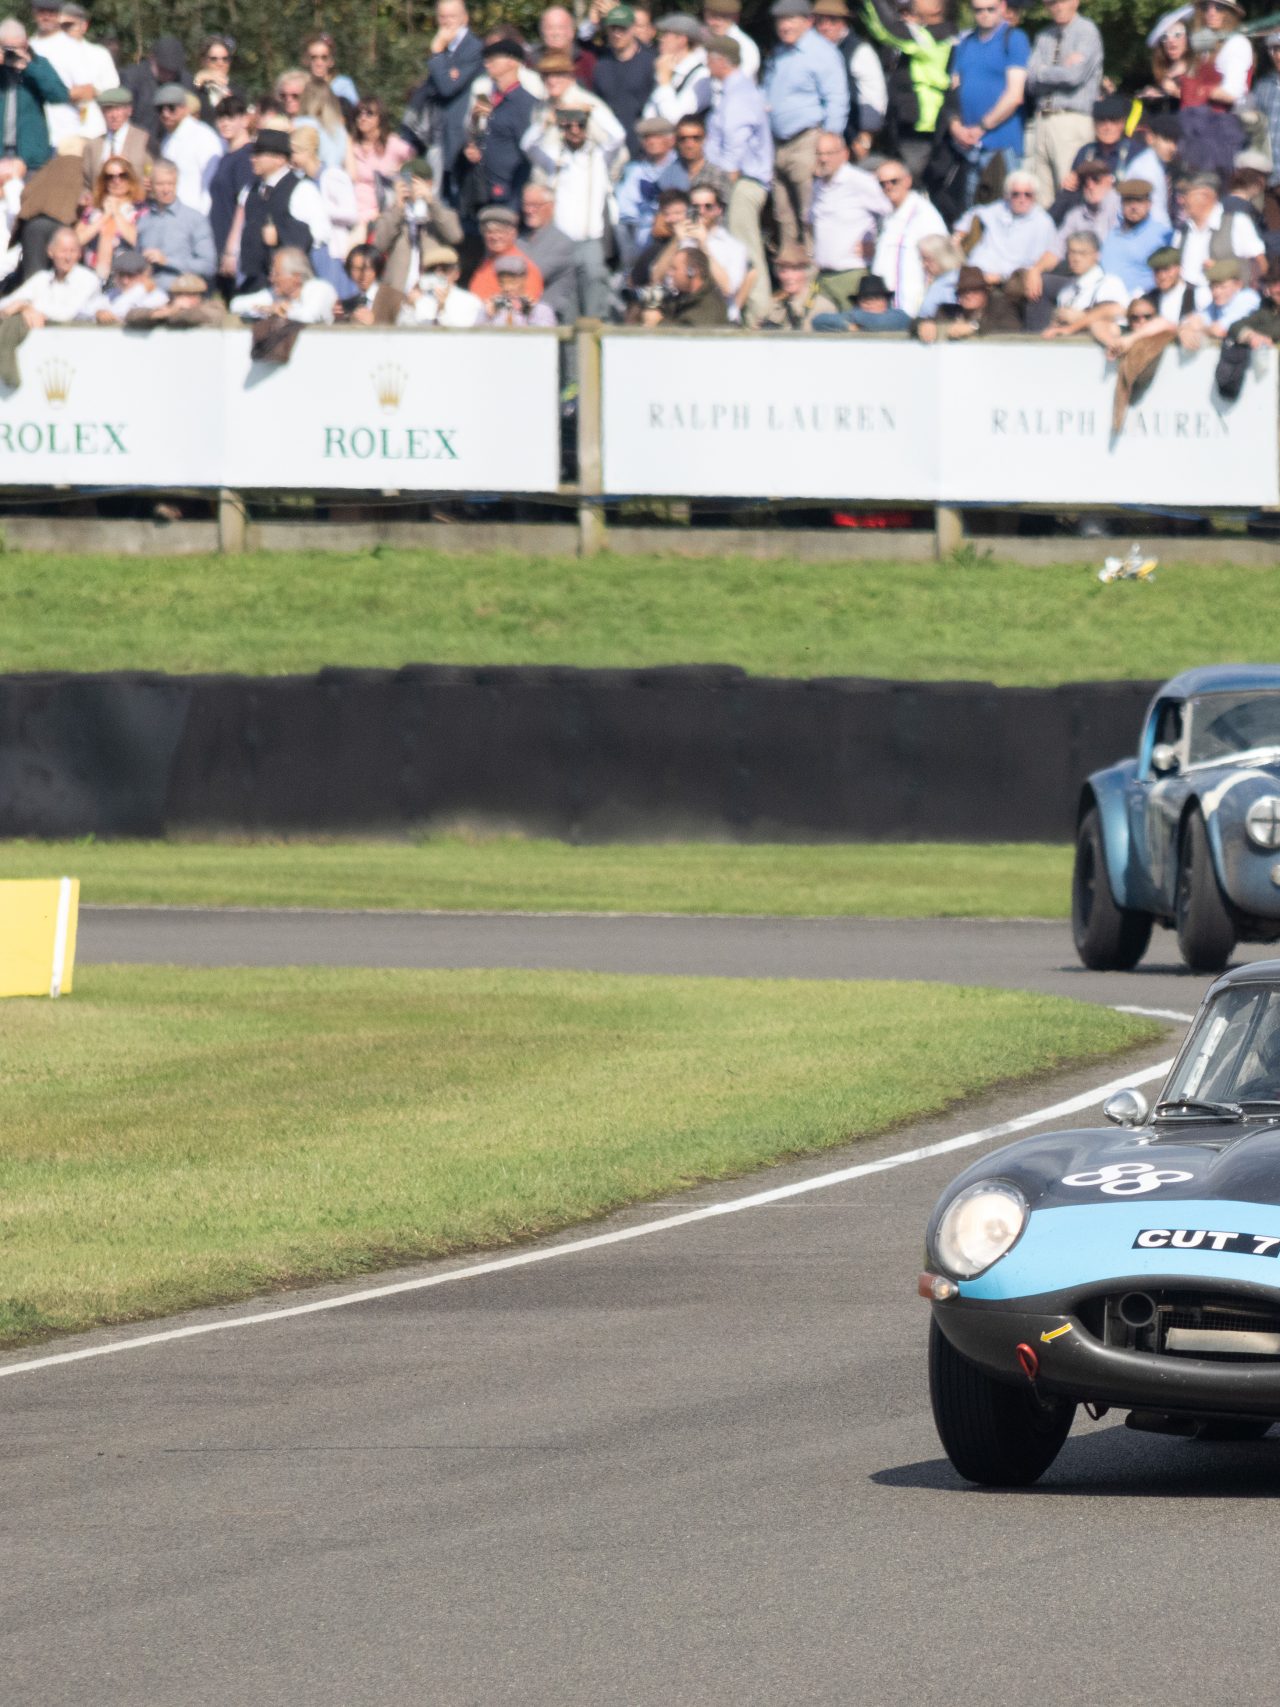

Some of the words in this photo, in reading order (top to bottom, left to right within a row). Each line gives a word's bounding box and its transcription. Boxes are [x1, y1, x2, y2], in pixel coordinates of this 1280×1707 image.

[648, 403, 751, 431] RALPH
[767, 404, 897, 432] LAUREN
[991, 408, 1095, 435] RALPH
[1123, 409, 1231, 438] AUREN
[324, 427, 459, 459] ROLEX
[1061, 1162, 1194, 1195] 88
[1137, 1229, 1239, 1250] CUT
[1252, 1235, 1280, 1255] 7
